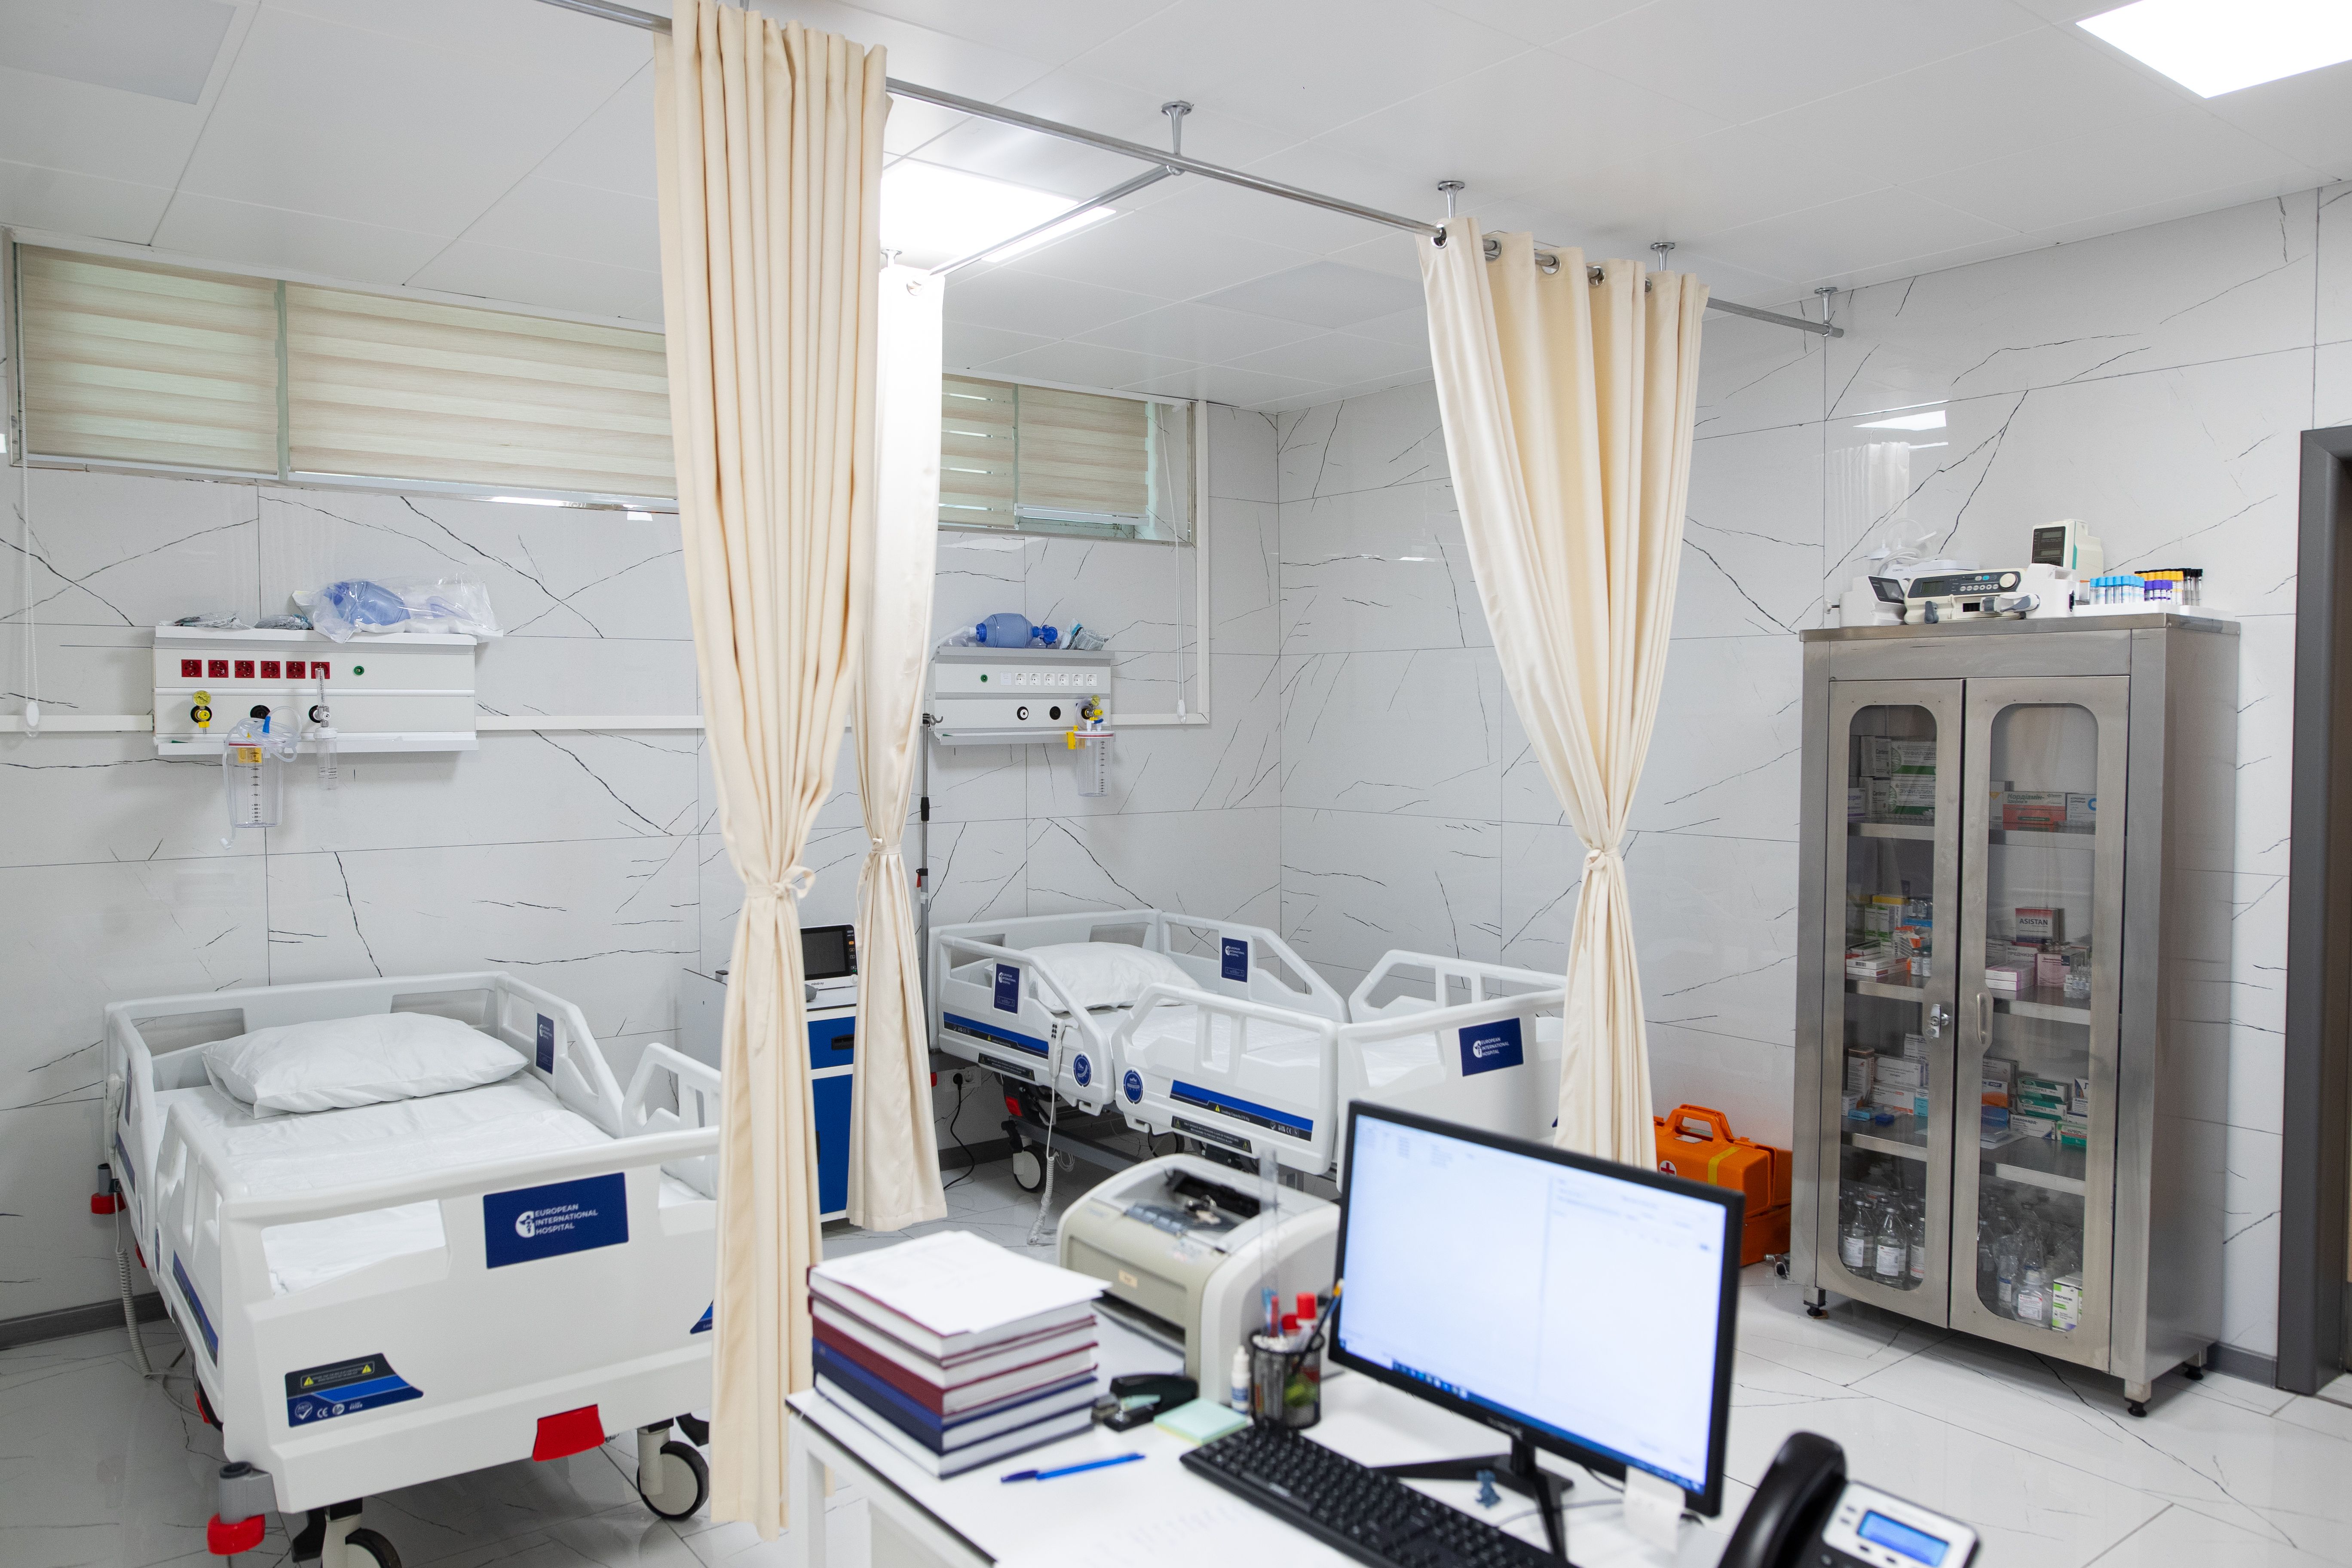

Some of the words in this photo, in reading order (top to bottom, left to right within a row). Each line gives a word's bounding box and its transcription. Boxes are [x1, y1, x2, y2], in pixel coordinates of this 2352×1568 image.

[1481, 1037, 1501, 1045] EUROPEAN
[1482, 1041, 1509, 1050] INTERNATIONAL
[535, 1204, 579, 1217] EUROPEAN
[536, 1209, 598, 1226] INTERNATIONAL
[536, 1222, 575, 1235] HOSPITAL
